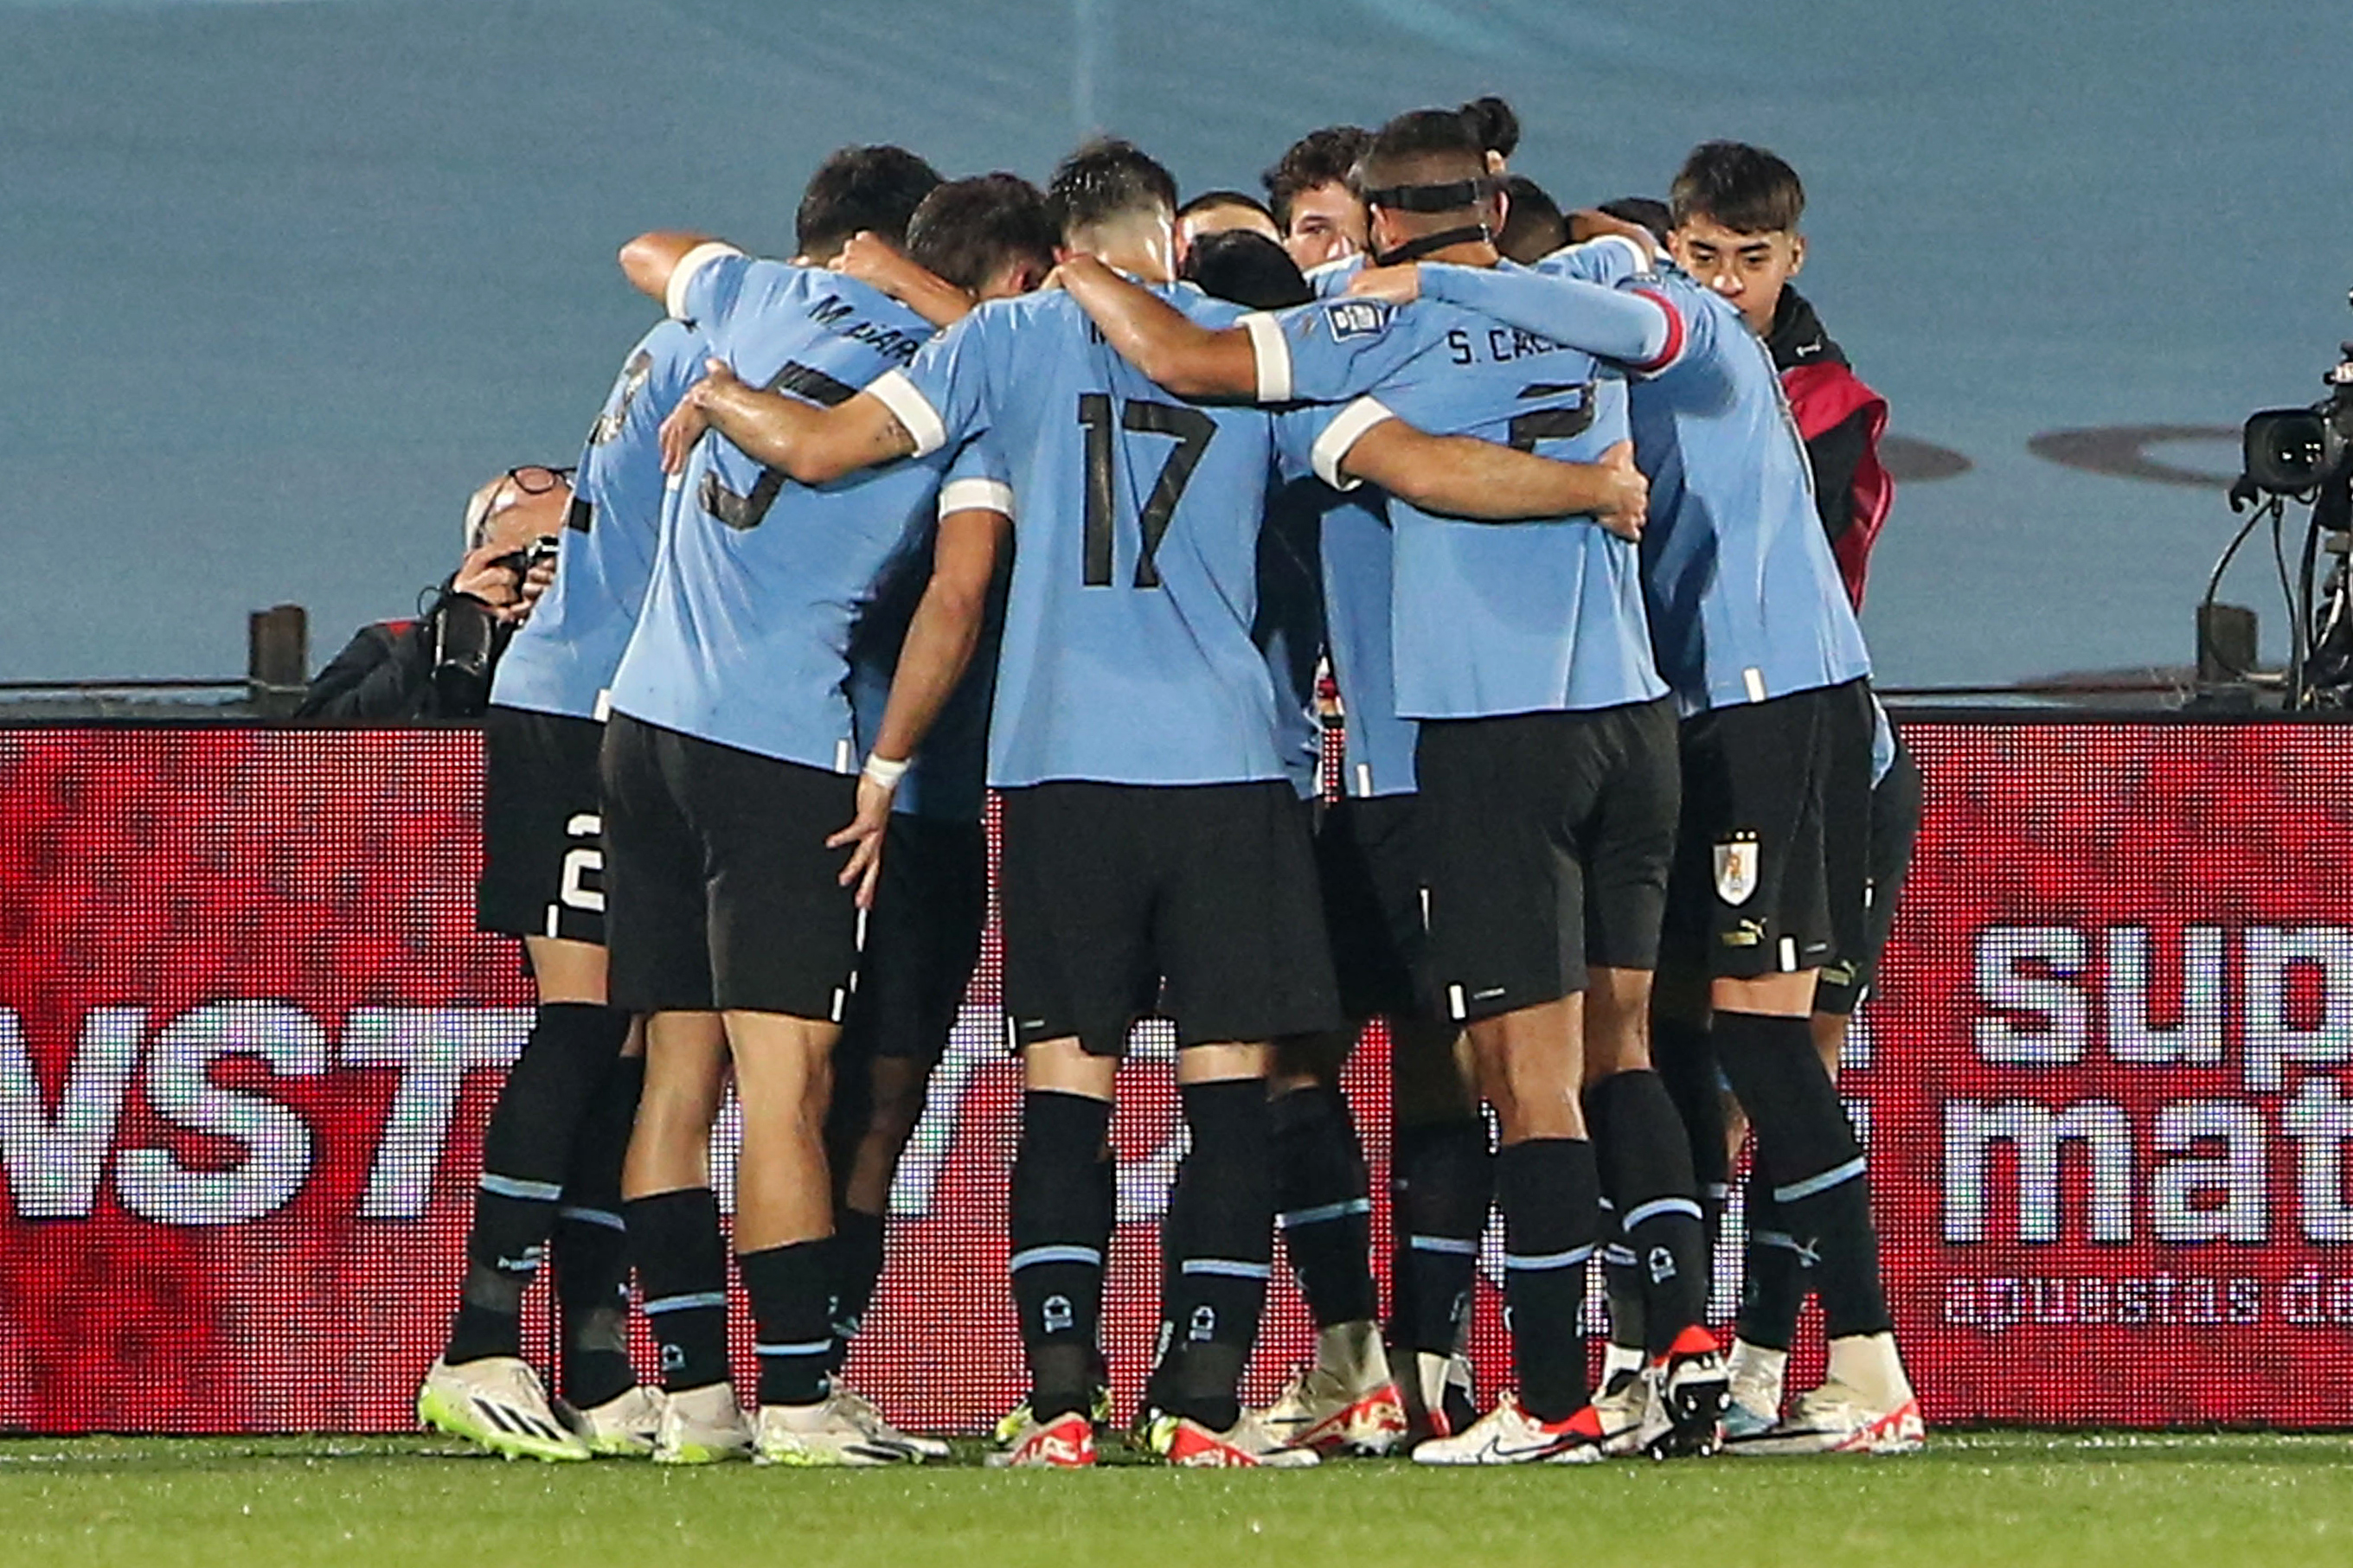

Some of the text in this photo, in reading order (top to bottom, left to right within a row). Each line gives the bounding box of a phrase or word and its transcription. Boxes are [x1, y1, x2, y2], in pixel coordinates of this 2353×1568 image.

[1447, 329, 1481, 364] S.
[1079, 392, 1217, 587] 17
[1944, 1076, 2353, 1242] mat
[1945, 1277, 2260, 1330] apuestas
